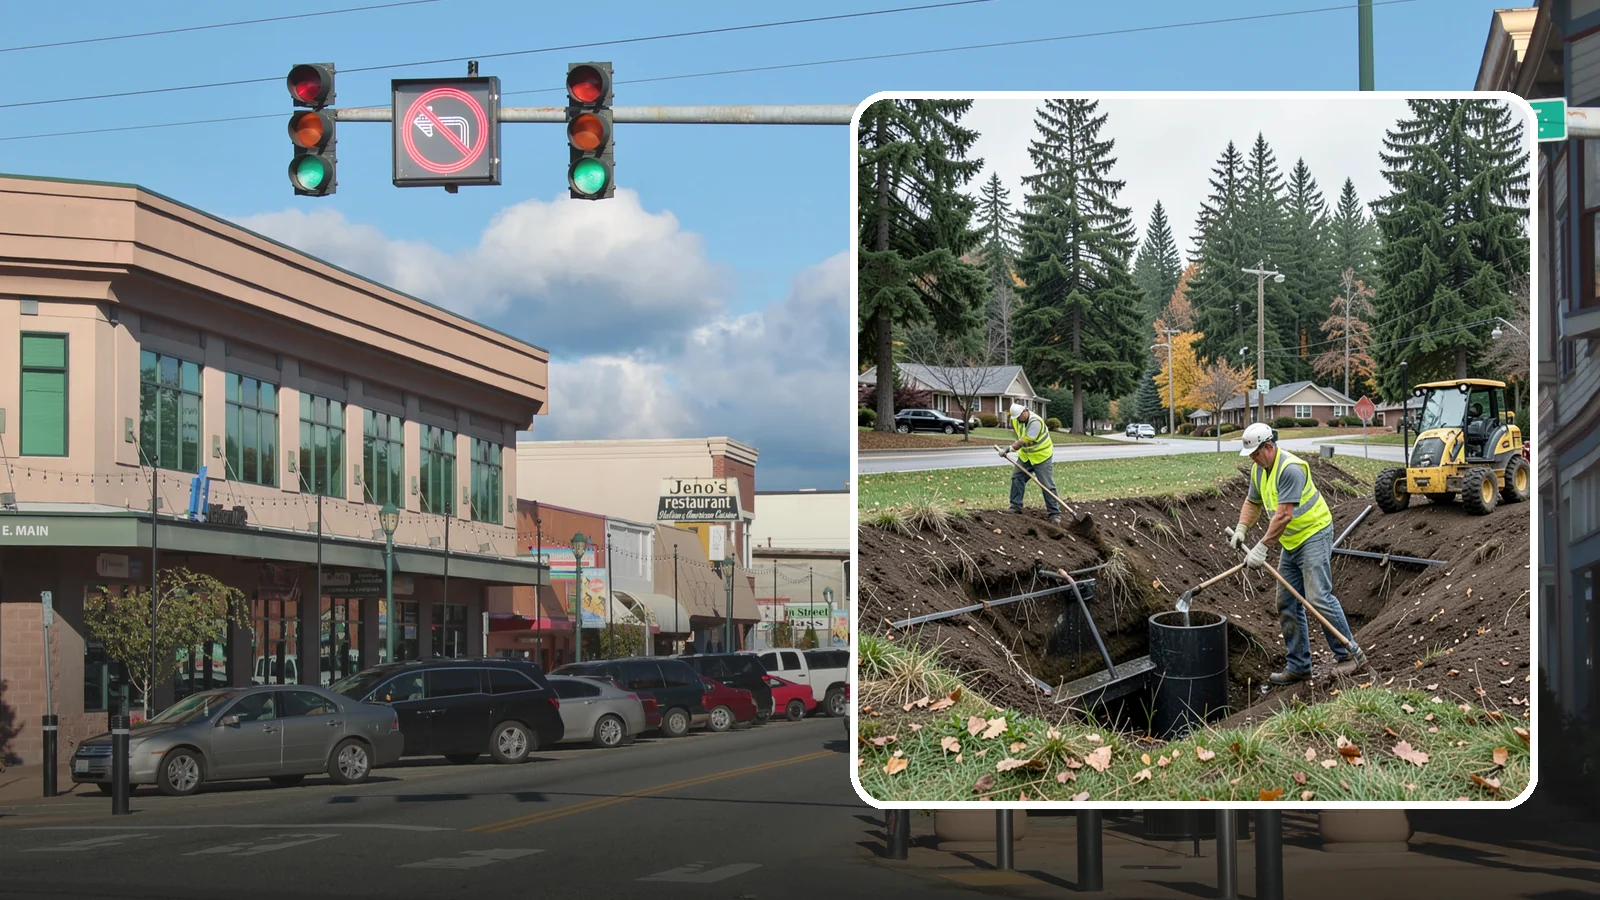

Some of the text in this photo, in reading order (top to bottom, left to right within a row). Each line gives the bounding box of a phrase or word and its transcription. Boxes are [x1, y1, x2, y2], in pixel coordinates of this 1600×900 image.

[670, 480, 727, 494] Jeno's
[665, 496, 731, 509] restaurant
[686, 510, 714, 519] American
[715, 510, 737, 519] Cuisine
[2, 525, 49, 536] E. MAIN
[797, 607, 828, 616] Street
